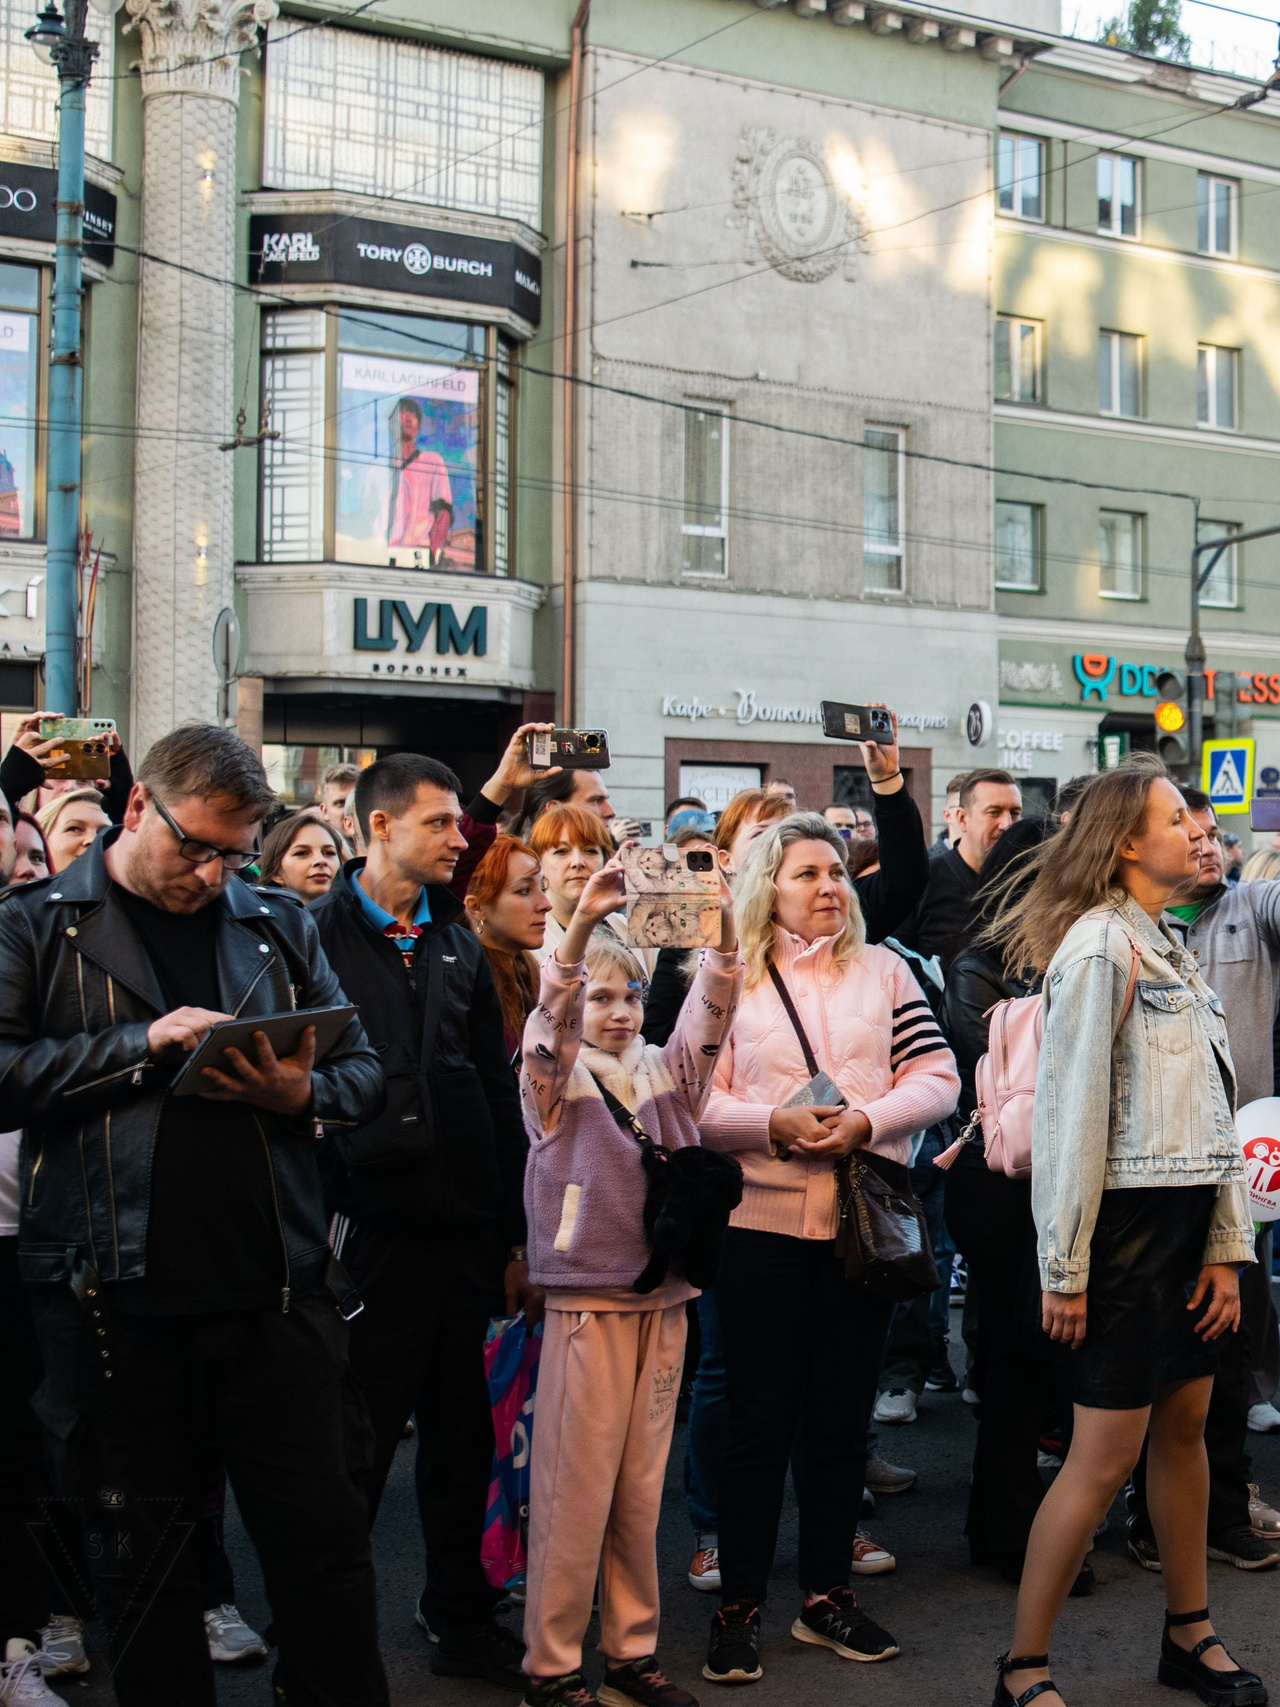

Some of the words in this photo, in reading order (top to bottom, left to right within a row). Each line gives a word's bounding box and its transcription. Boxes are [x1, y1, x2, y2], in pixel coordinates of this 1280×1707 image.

[82, 209, 113, 234] INSET
[263, 232, 320, 253] KARL
[356, 243, 402, 262] TORY
[433, 255, 493, 278] BURCH
[355, 368, 388, 383] KARL
[391, 373, 466, 392] LAGERFELD
[354, 598, 487, 656] ЦУМ
[373, 664, 467, 677] ВОРОНЕЖ
[1120, 664, 1165, 697] DD
[662, 694, 712, 722] Кафе
[733, 687, 823, 725] Волкон
[896, 713, 949, 733] екарня
[539, 1002, 556, 1025] ADE
